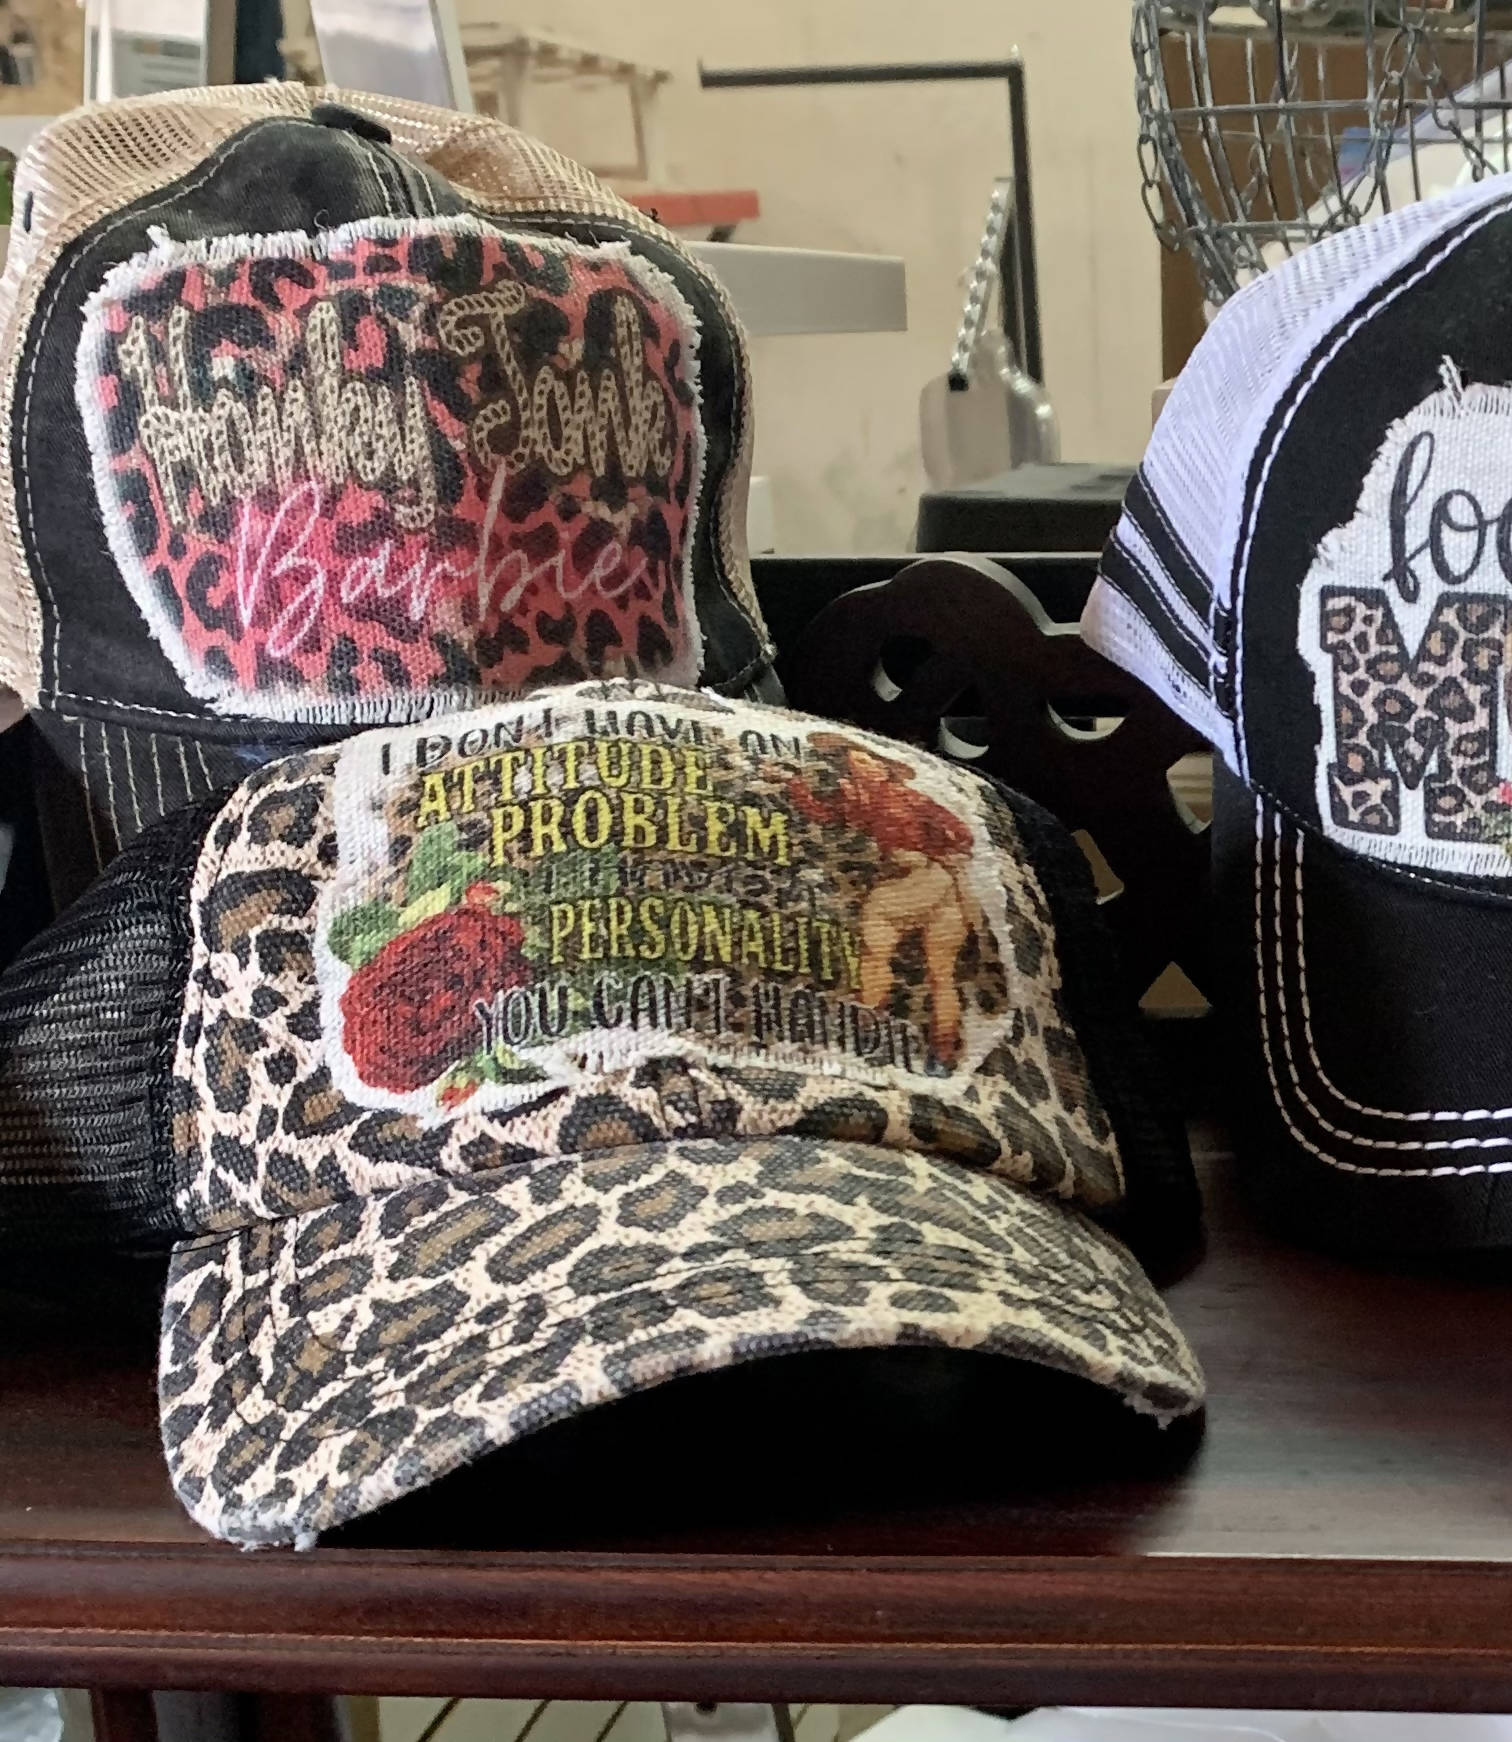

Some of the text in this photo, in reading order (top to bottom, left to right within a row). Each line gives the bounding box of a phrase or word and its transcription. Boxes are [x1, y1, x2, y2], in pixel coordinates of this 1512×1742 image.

[233, 466, 662, 657] Barbie
[416, 736, 714, 828] ATTITUDE
[490, 788, 790, 868] PROBLEM
[549, 897, 862, 989] PERSONALITY
[474, 981, 568, 1056] YOU
